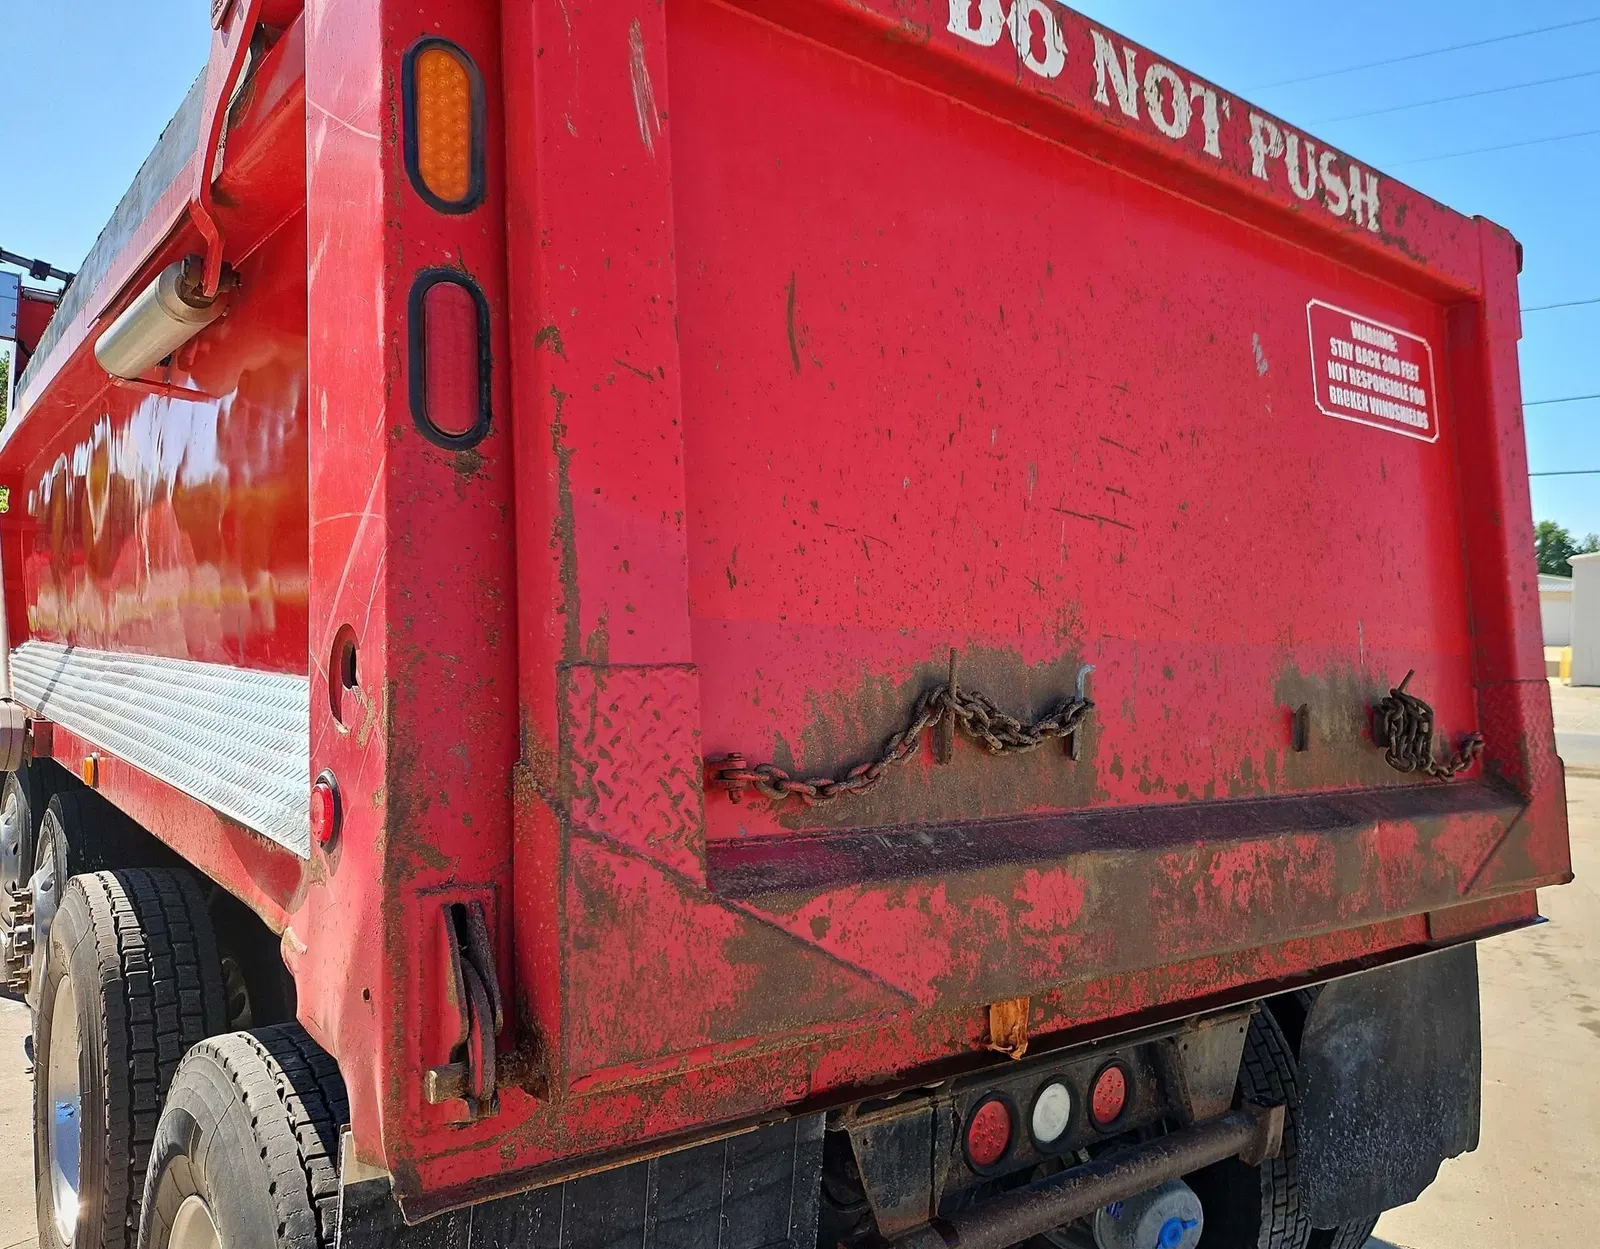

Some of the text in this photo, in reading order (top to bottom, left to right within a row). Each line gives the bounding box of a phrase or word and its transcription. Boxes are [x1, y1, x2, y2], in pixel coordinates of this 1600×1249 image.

[947, 0, 1381, 233] DO NOT PUSH
[1330, 337, 1354, 360] STAY
[1355, 345, 1381, 370] BACK
[1401, 360, 1419, 383] FEET
[1328, 360, 1426, 407] NOT RESPONSIBLE FOR
[1329, 385, 1429, 430] BROKEN WINDSHIELDS
